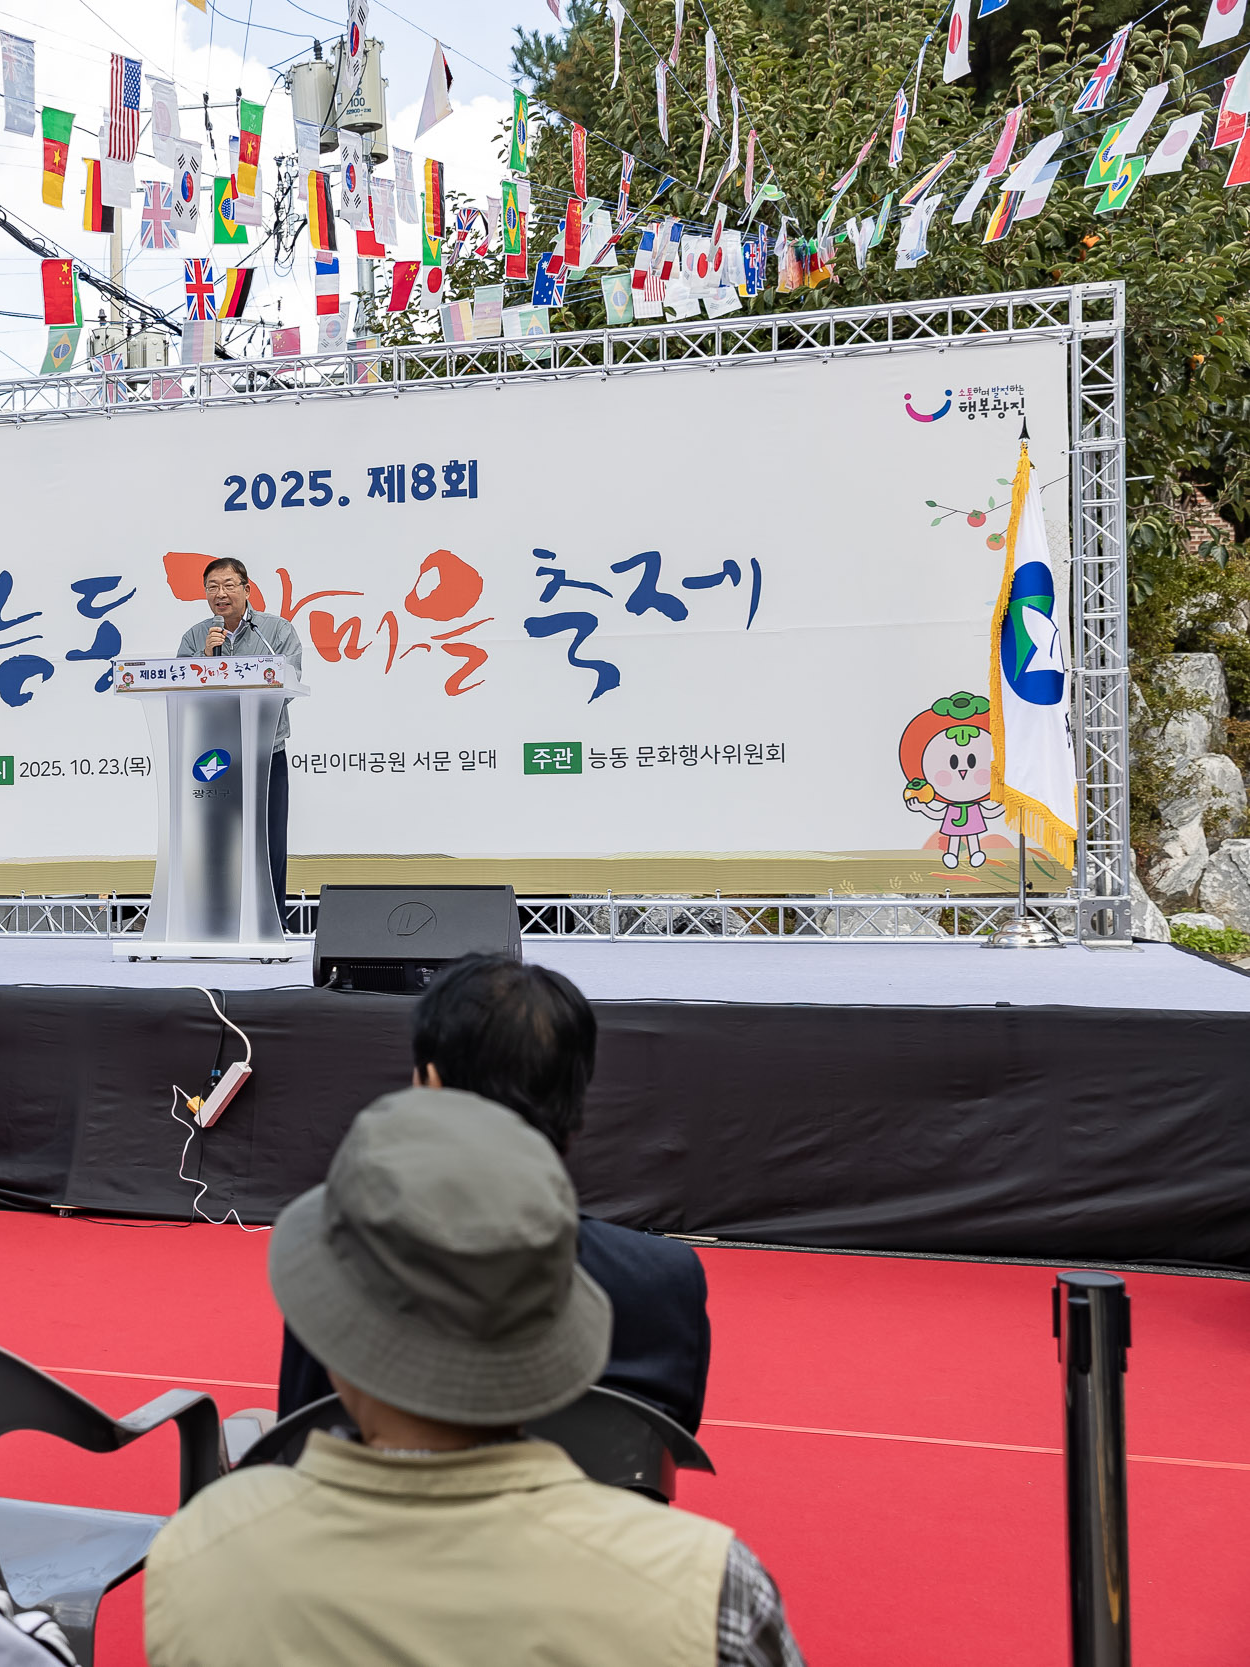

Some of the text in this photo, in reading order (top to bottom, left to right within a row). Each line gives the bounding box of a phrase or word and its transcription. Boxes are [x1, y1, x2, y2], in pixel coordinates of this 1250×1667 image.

[351, 97, 366, 107] 100
[958, 384, 1025, 400] 소통하며 발전하는
[958, 397, 1025, 421] 행복광진
[223, 459, 478, 512] 2025. 제8회
[524, 548, 762, 704] 축제
[139, 661, 259, 683] 제8회 능동 감마을 축제
[19, 761, 65, 777] 2025.
[71, 759, 95, 775] 10.
[98, 754, 152, 777] 23.(목)
[291, 752, 406, 774] 어린이대공원
[413, 752, 452, 772] 서문
[458, 749, 498, 770] 일대
[531, 747, 574, 770] 주관
[589, 746, 629, 768] 능동
[636, 742, 787, 767] 문화행사위원회
[192, 789, 231, 799] 광진구
